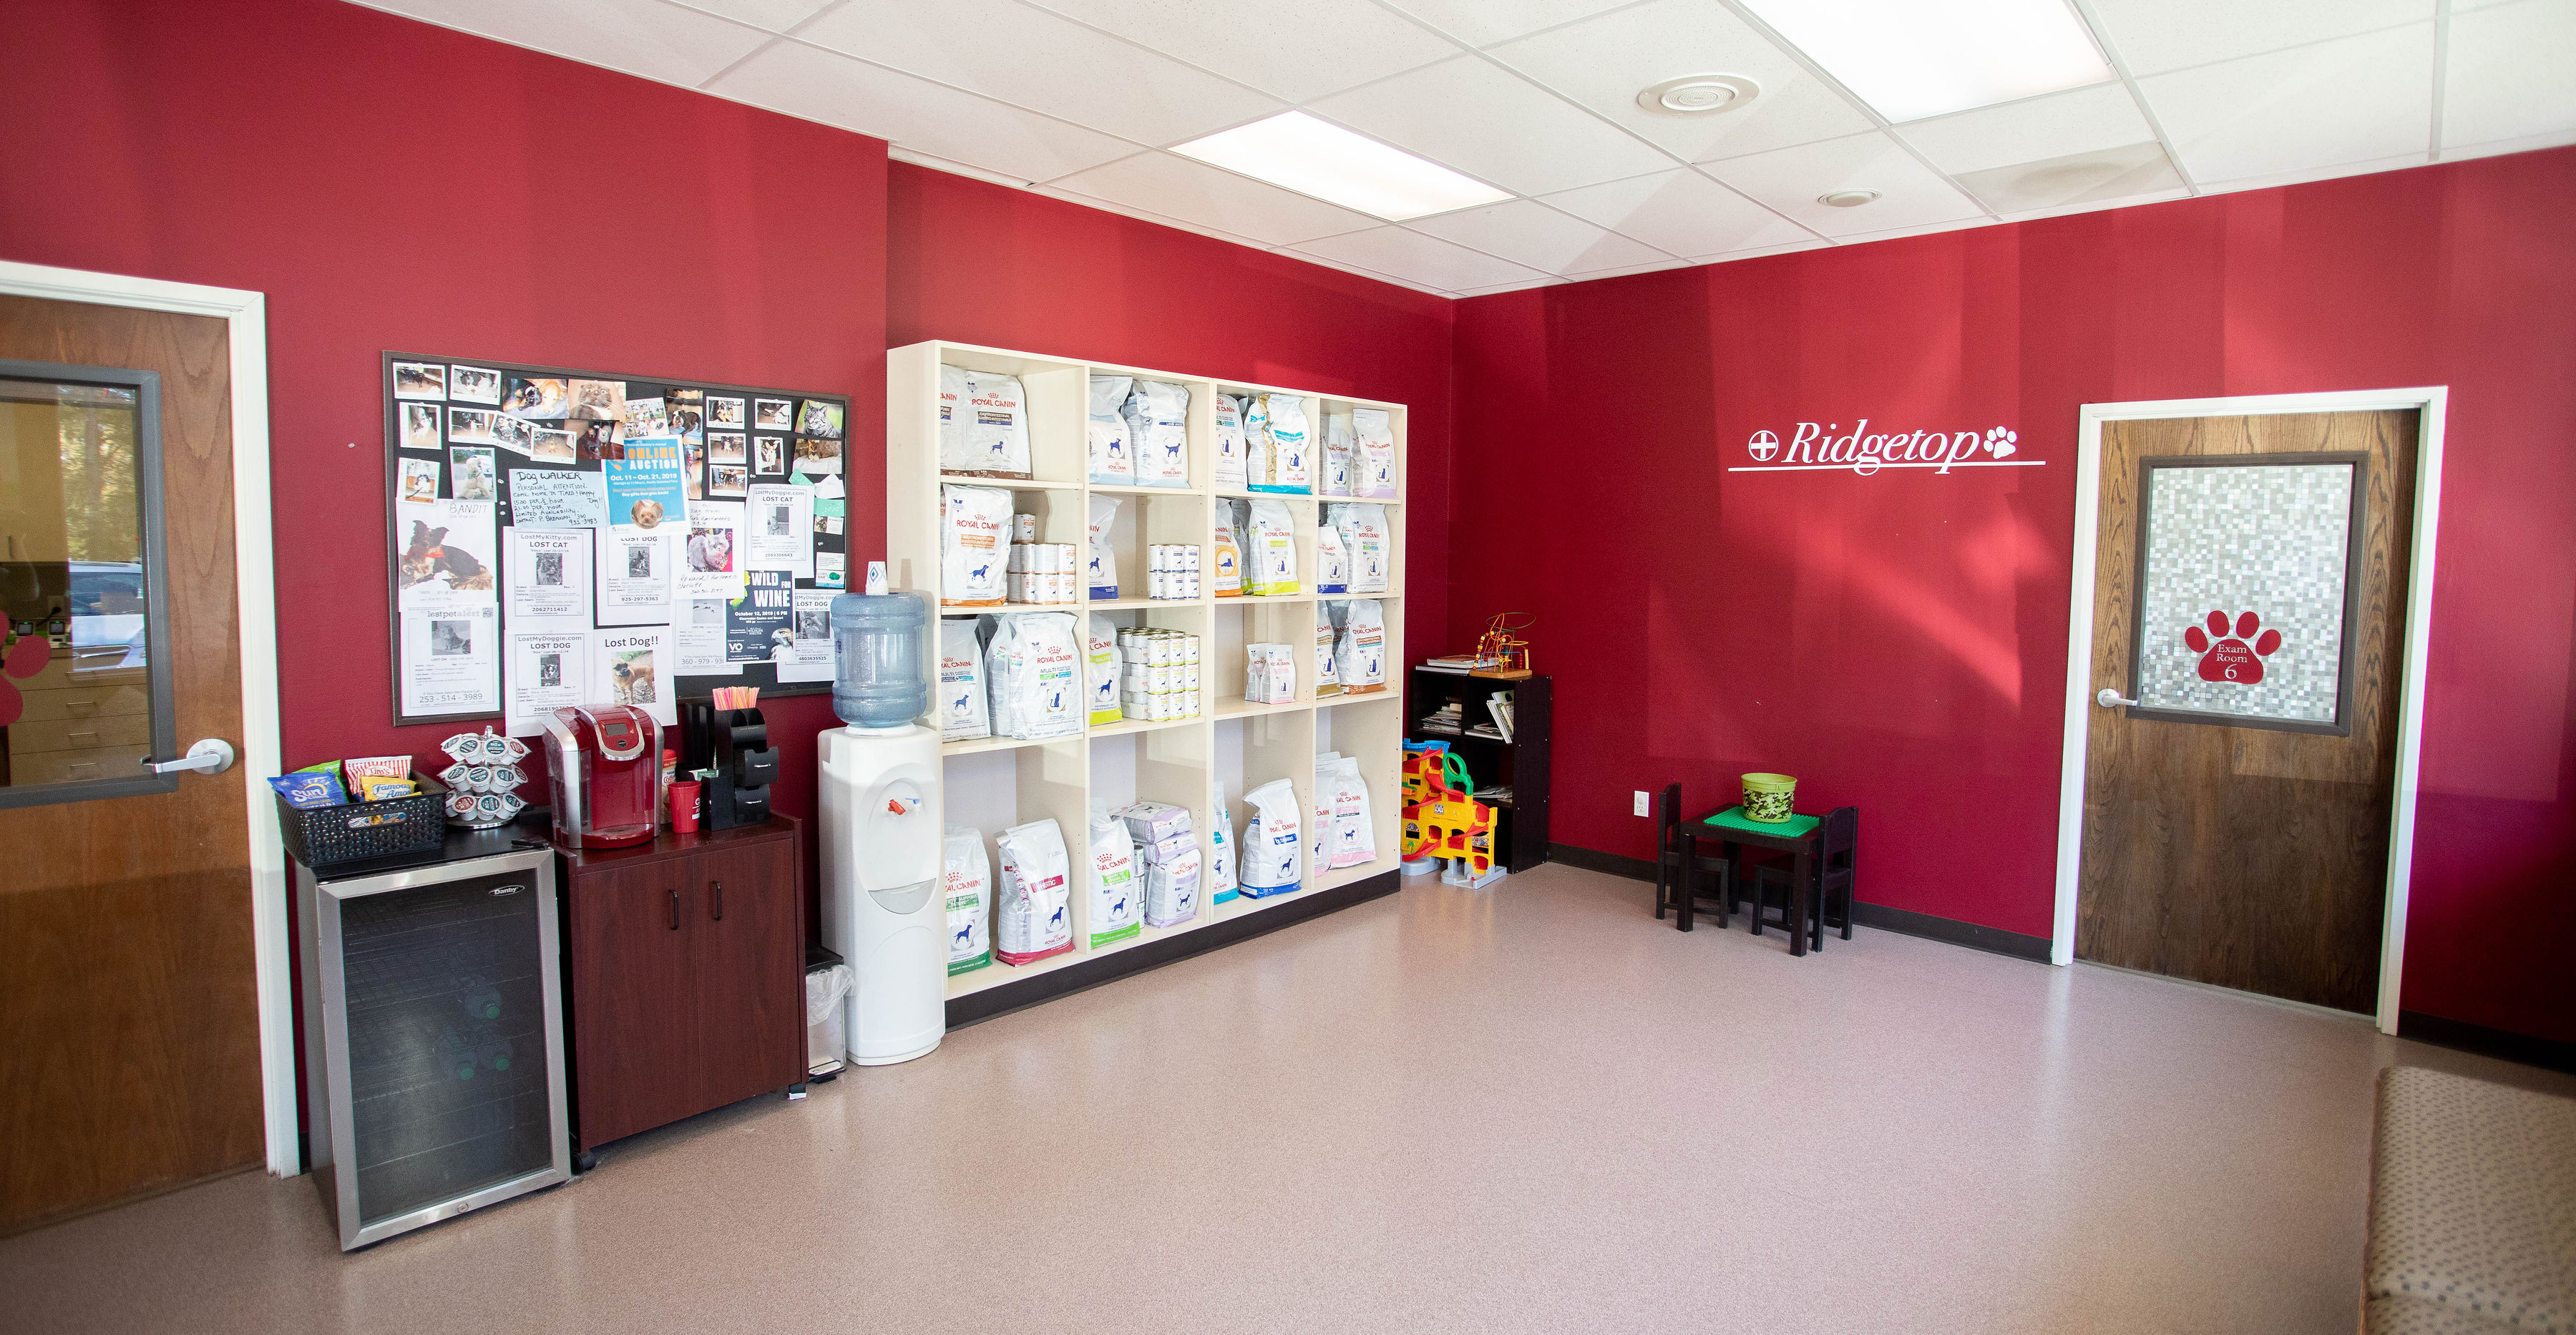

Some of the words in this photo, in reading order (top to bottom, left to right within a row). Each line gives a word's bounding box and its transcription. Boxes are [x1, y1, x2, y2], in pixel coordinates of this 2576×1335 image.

[940, 392, 957, 401] ANIN
[628, 447, 676, 459] ONLINE
[1781, 419, 1980, 476] Ridgetop
[630, 459, 678, 470] AUCTION
[517, 472, 538, 484] Dog
[540, 471, 582, 480] WALKER
[449, 502, 487, 514] BANDIT
[957, 519, 979, 529] ROYAL
[751, 572, 779, 586] WILD
[753, 590, 790, 607] WINE
[605, 638, 627, 647] Lost
[630, 636, 658, 647] Dog!!
[2218, 644, 2247, 653] Exam
[2216, 653, 2248, 663] Room
[2225, 663, 2238, 680] 6
[369, 766, 390, 776] Tim's
[372, 783, 411, 795] Famous
[291, 788, 322, 803] Sun
[1282, 822, 1297, 831] CANIN
[1109, 856, 1130, 868] CANIN
[957, 880, 981, 890] CANIN
